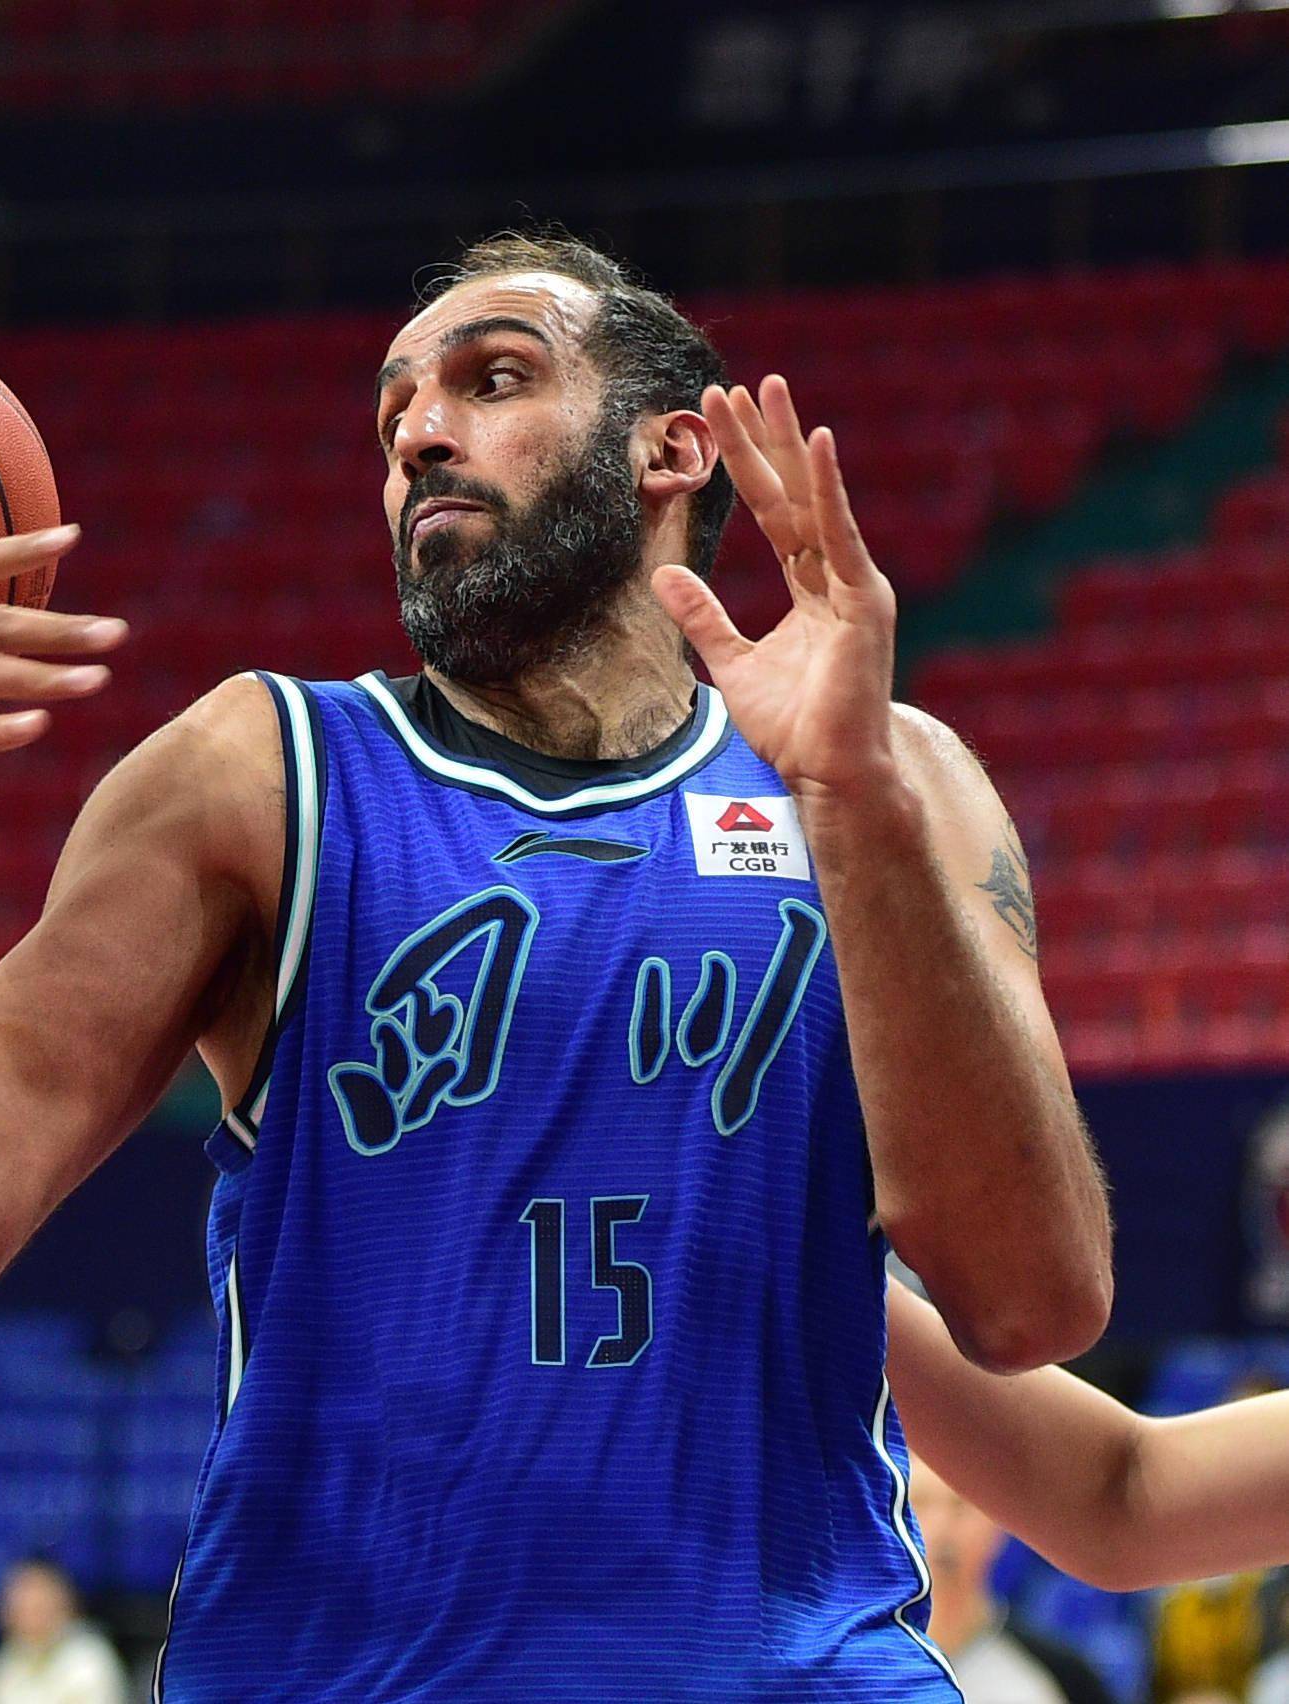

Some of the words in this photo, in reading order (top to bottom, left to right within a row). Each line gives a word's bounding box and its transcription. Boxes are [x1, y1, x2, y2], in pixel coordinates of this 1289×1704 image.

[711, 841, 790, 857] 广发银行
[729, 857, 778, 873] CGB
[518, 1194, 653, 1369] 15
